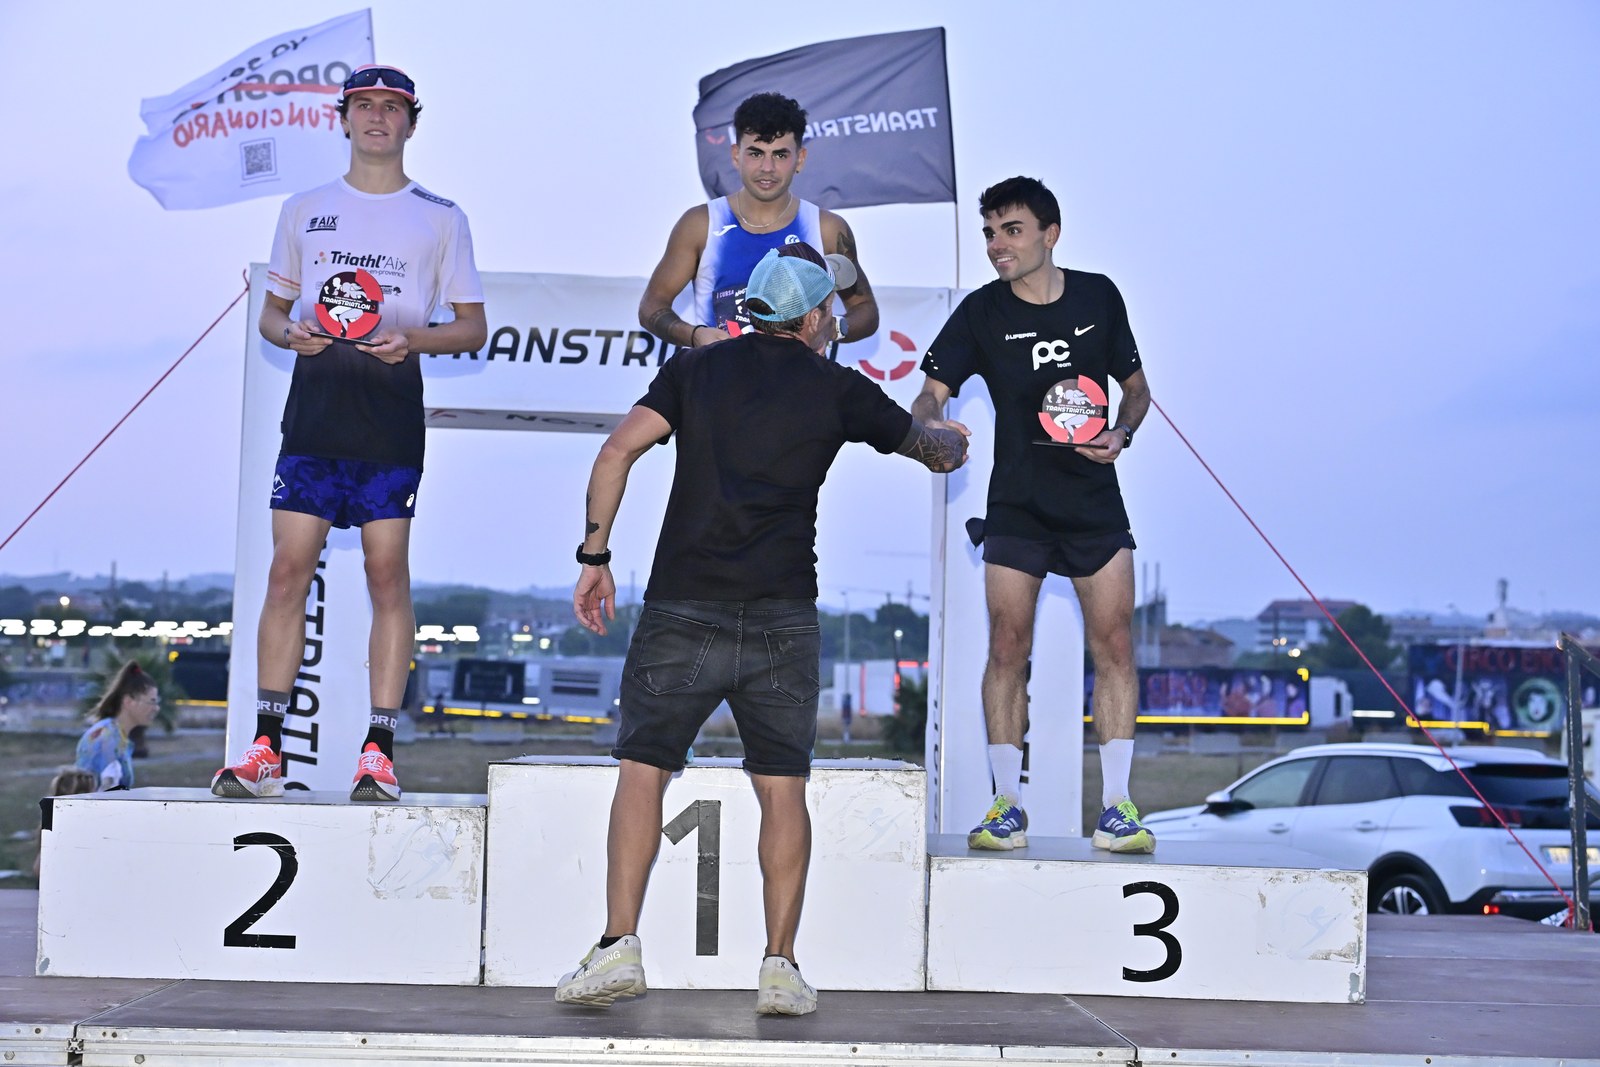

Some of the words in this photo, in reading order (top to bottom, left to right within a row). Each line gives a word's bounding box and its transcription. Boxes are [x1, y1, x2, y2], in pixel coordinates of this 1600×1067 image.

[319, 216, 338, 226] AIX
[330, 251, 407, 272] Triathl'Aix
[322, 296, 371, 310] TRANSTRIATLON
[1045, 405, 1096, 416] TRANSTRIATLON
[662, 799, 721, 957] 1
[223, 831, 299, 950] 2
[1122, 880, 1183, 983] 3
[584, 950, 621, 978] RUNNING
